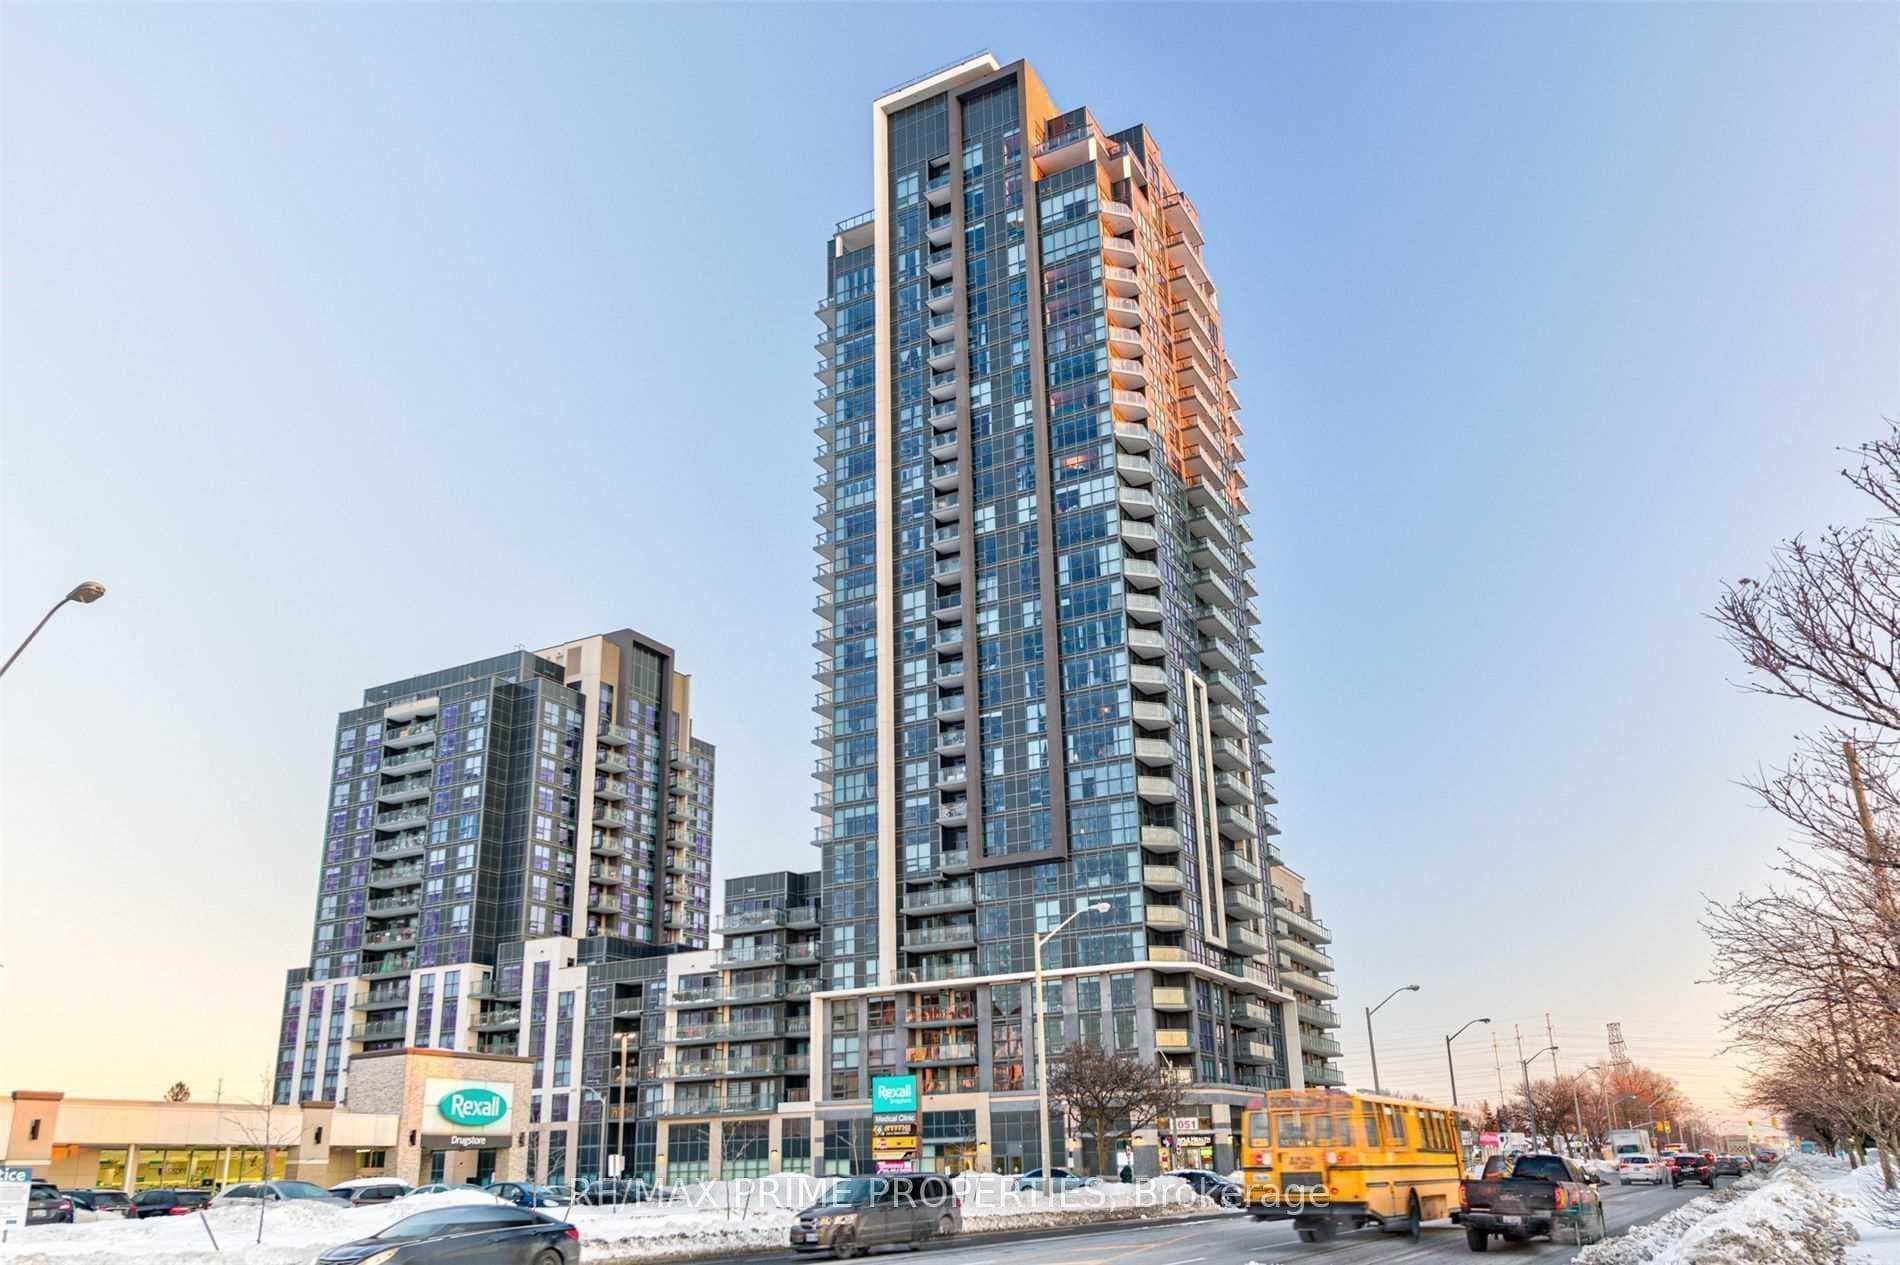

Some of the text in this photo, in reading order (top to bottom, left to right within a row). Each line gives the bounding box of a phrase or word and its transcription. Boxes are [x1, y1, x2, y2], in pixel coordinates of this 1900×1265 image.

[878, 1084, 912, 1100] Rexall
[451, 1094, 500, 1118] Rexall
[1174, 1120, 1196, 1129] 051
[451, 1136, 486, 1146] Drugstore
